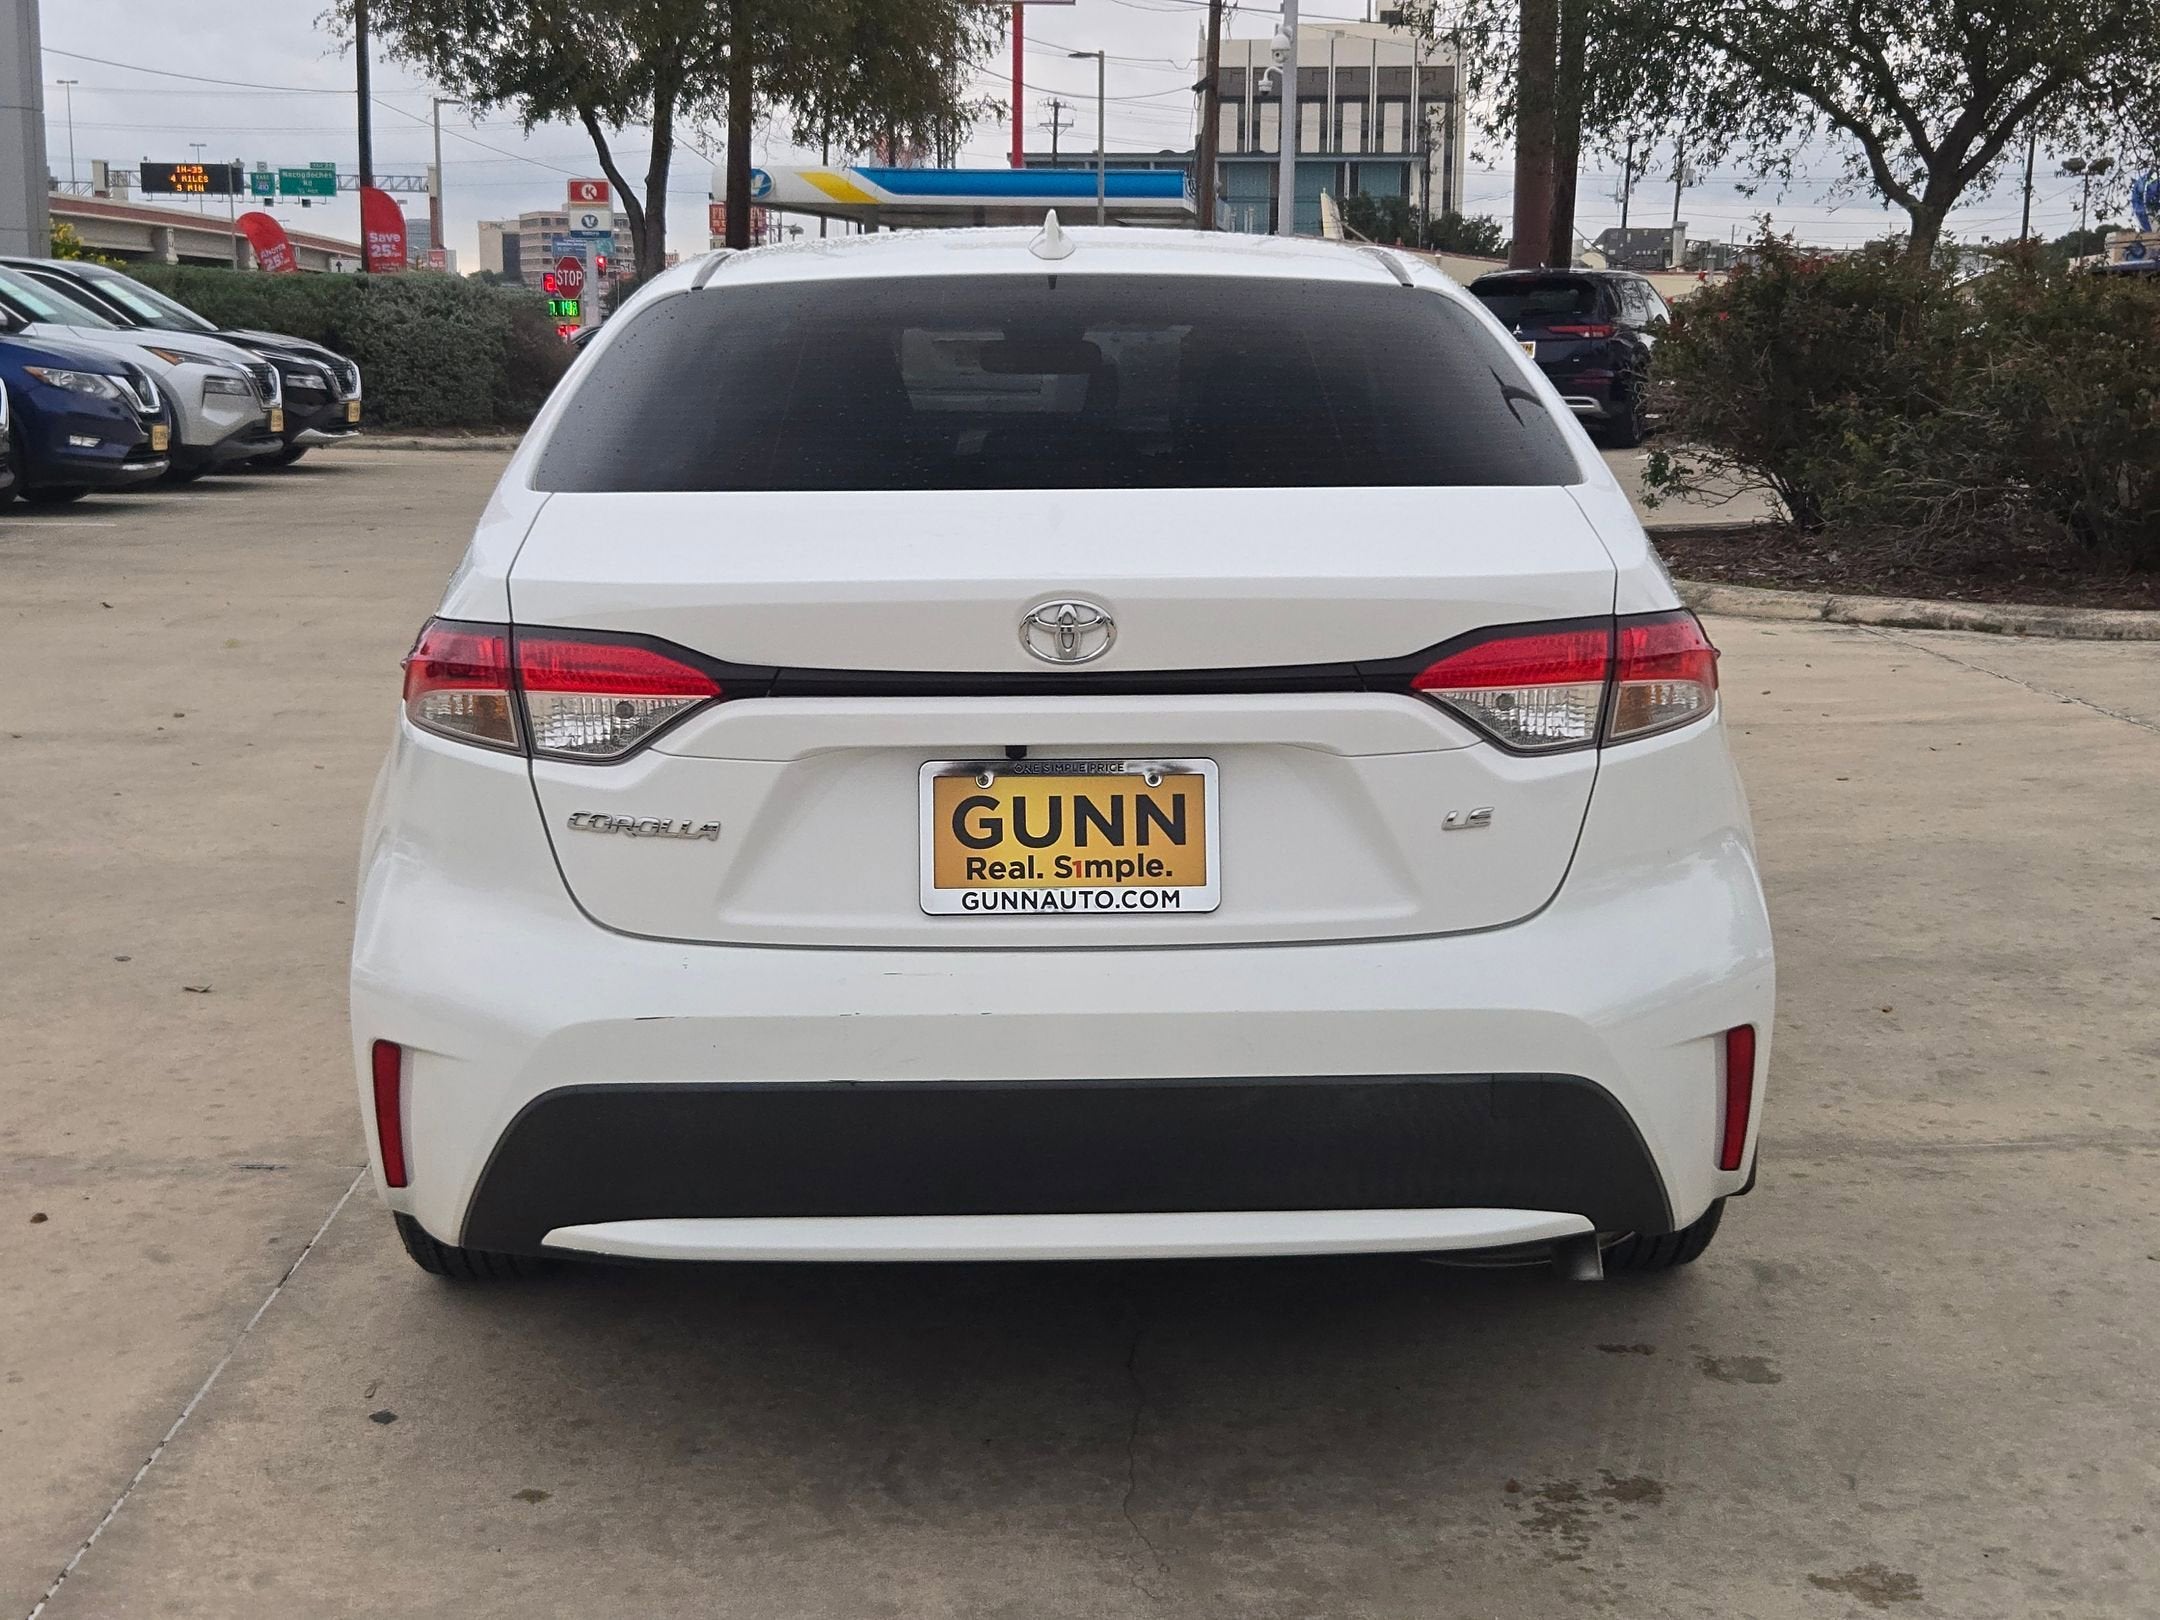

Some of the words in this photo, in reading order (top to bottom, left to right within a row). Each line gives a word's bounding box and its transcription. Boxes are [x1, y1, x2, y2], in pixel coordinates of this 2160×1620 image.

[170, 174, 177, 183] 4
[181, 175, 209, 183] MILES
[187, 184, 205, 192] MIN
[369, 232, 402, 243] Save
[557, 269, 583, 287] STOP
[1015, 763, 1040, 774] ONE
[1043, 762, 1086, 773] SIMPLE
[1090, 762, 1125, 773] PRICE
[567, 810, 721, 842] COROLLA
[952, 793, 1187, 849] GUNN
[1441, 806, 1495, 831] LE
[966, 855, 1044, 881] Real.
[961, 889, 1181, 911] GUNNAUTO.COM
